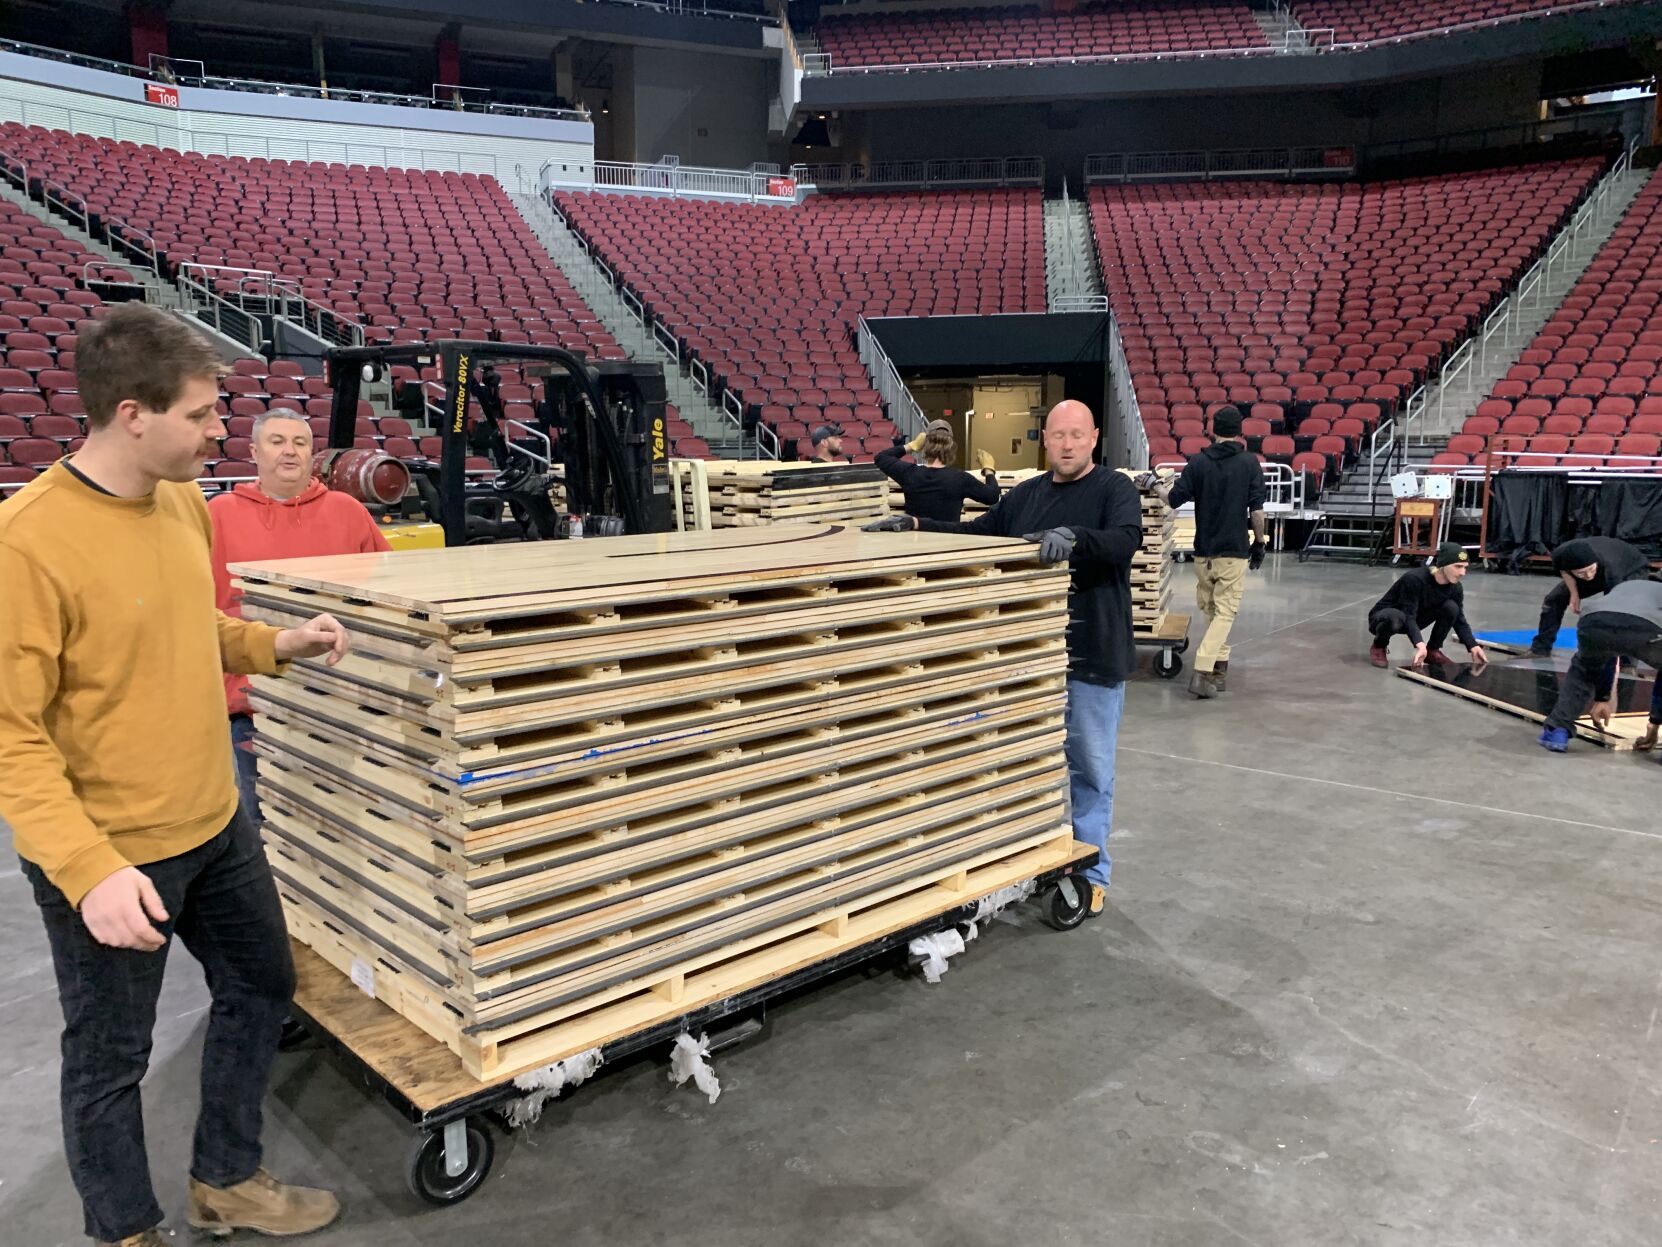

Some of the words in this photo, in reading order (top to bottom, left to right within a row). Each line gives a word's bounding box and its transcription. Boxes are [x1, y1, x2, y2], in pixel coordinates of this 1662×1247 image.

[158, 92, 178, 107] 108
[778, 185, 794, 197] 109
[458, 353, 469, 384] 80VX
[453, 385, 466, 433] Veracitor
[652, 418, 664, 460] Yale
